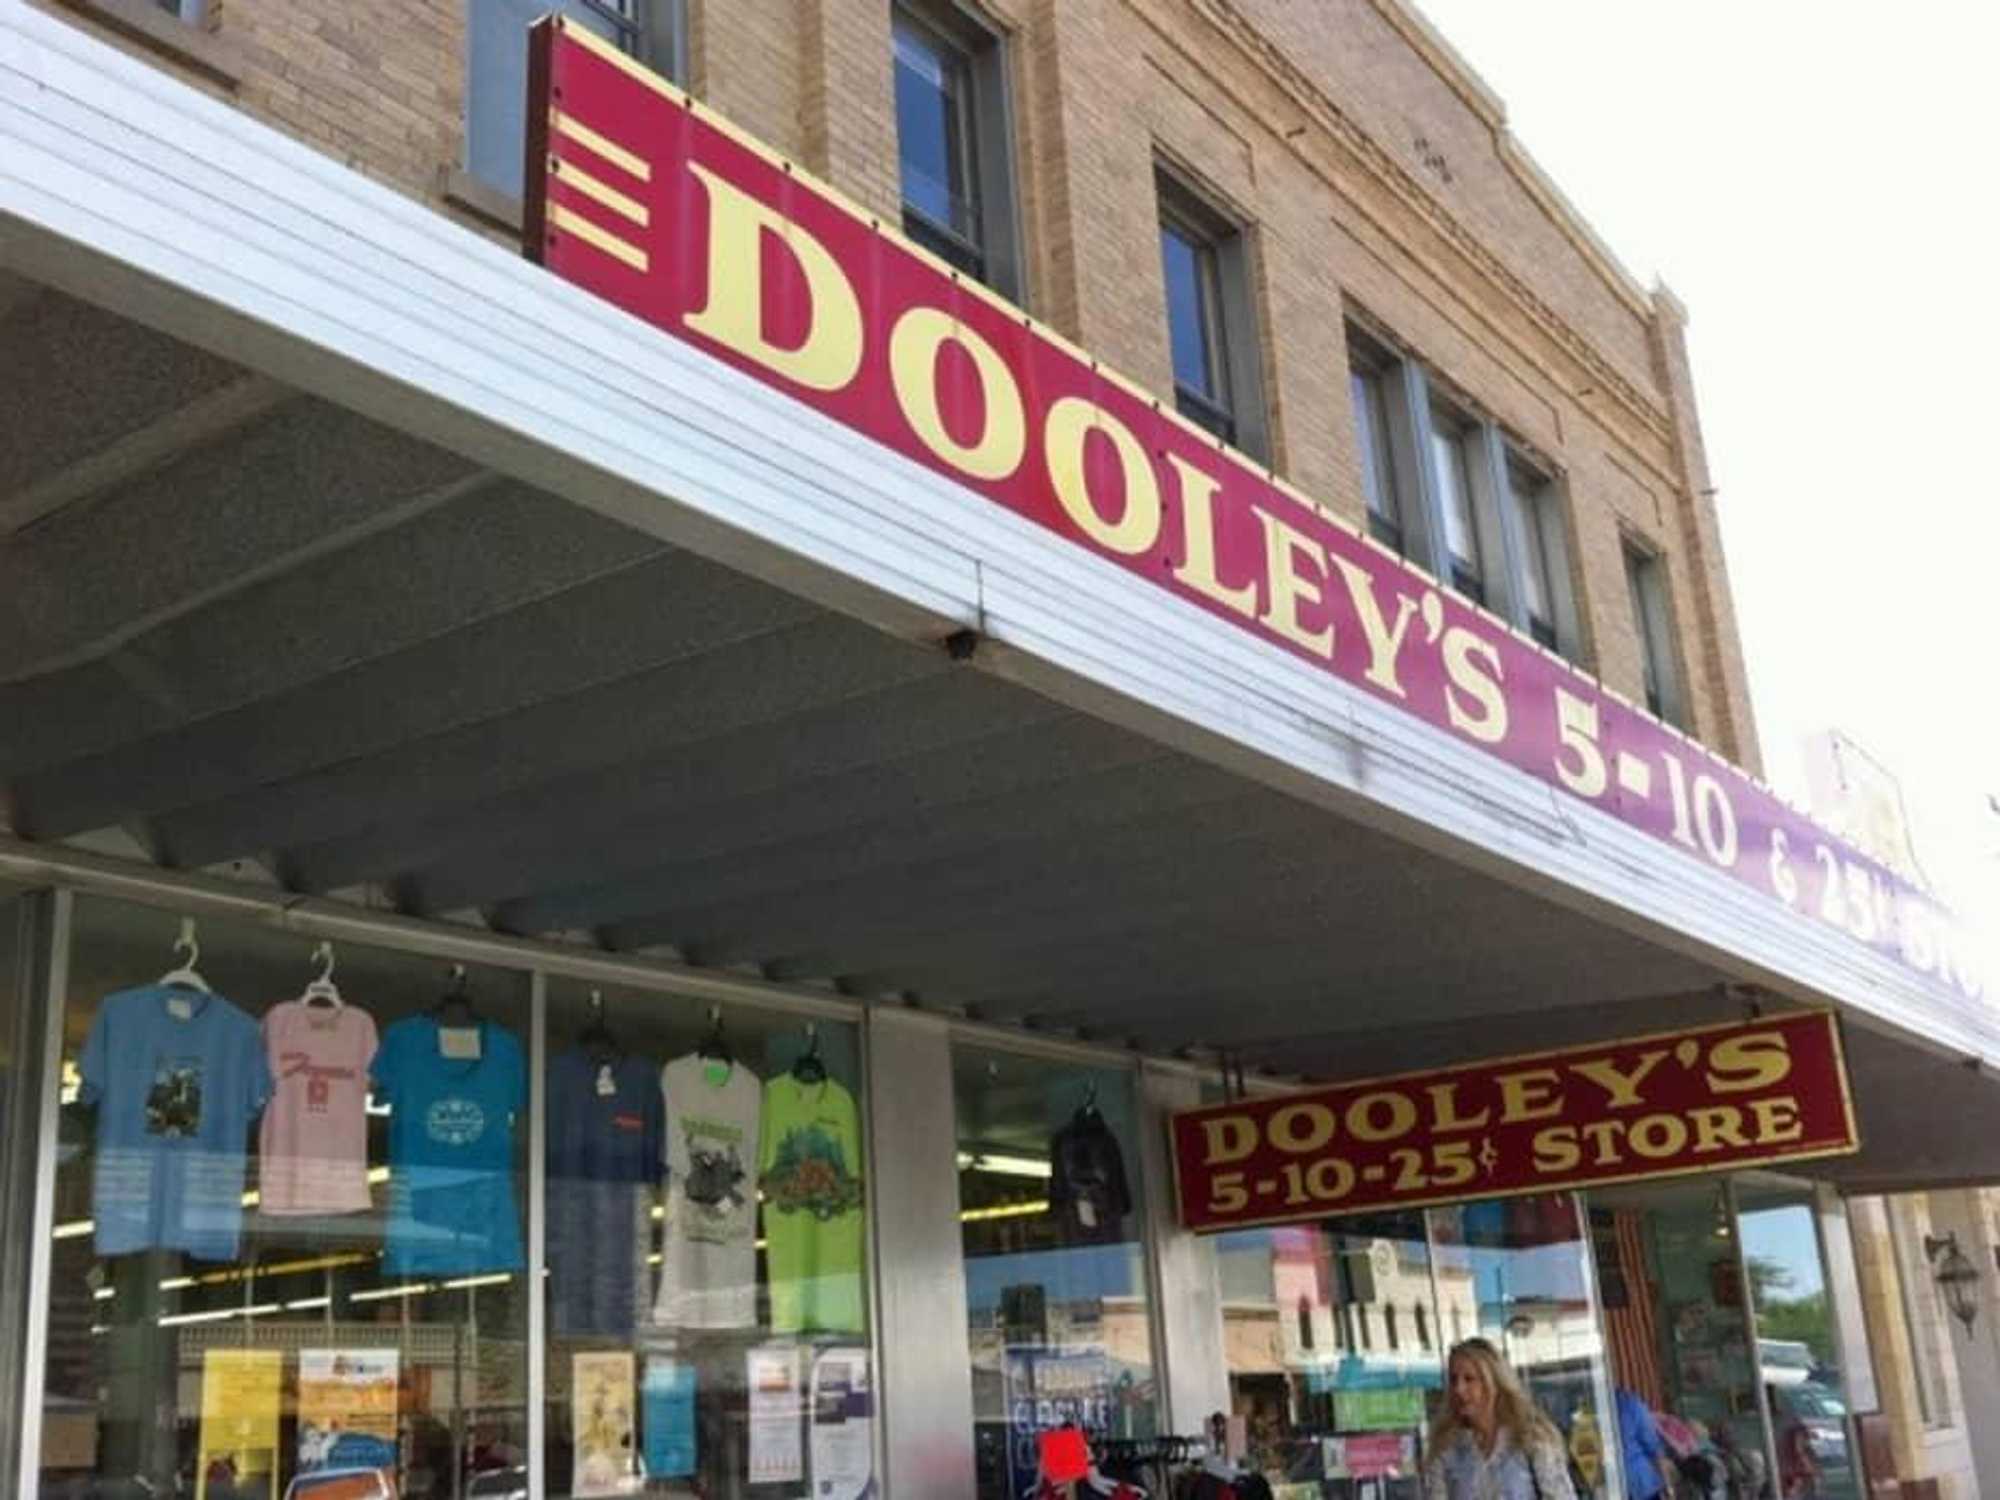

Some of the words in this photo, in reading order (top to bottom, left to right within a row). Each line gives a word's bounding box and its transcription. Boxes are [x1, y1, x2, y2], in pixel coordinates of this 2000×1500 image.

[683, 158, 1508, 743] DOOLEY'S
[1553, 685, 1738, 868] 5-10
[1202, 1031, 1792, 1165] DOOLEY'S
[1532, 1096, 1803, 1173] STORE
